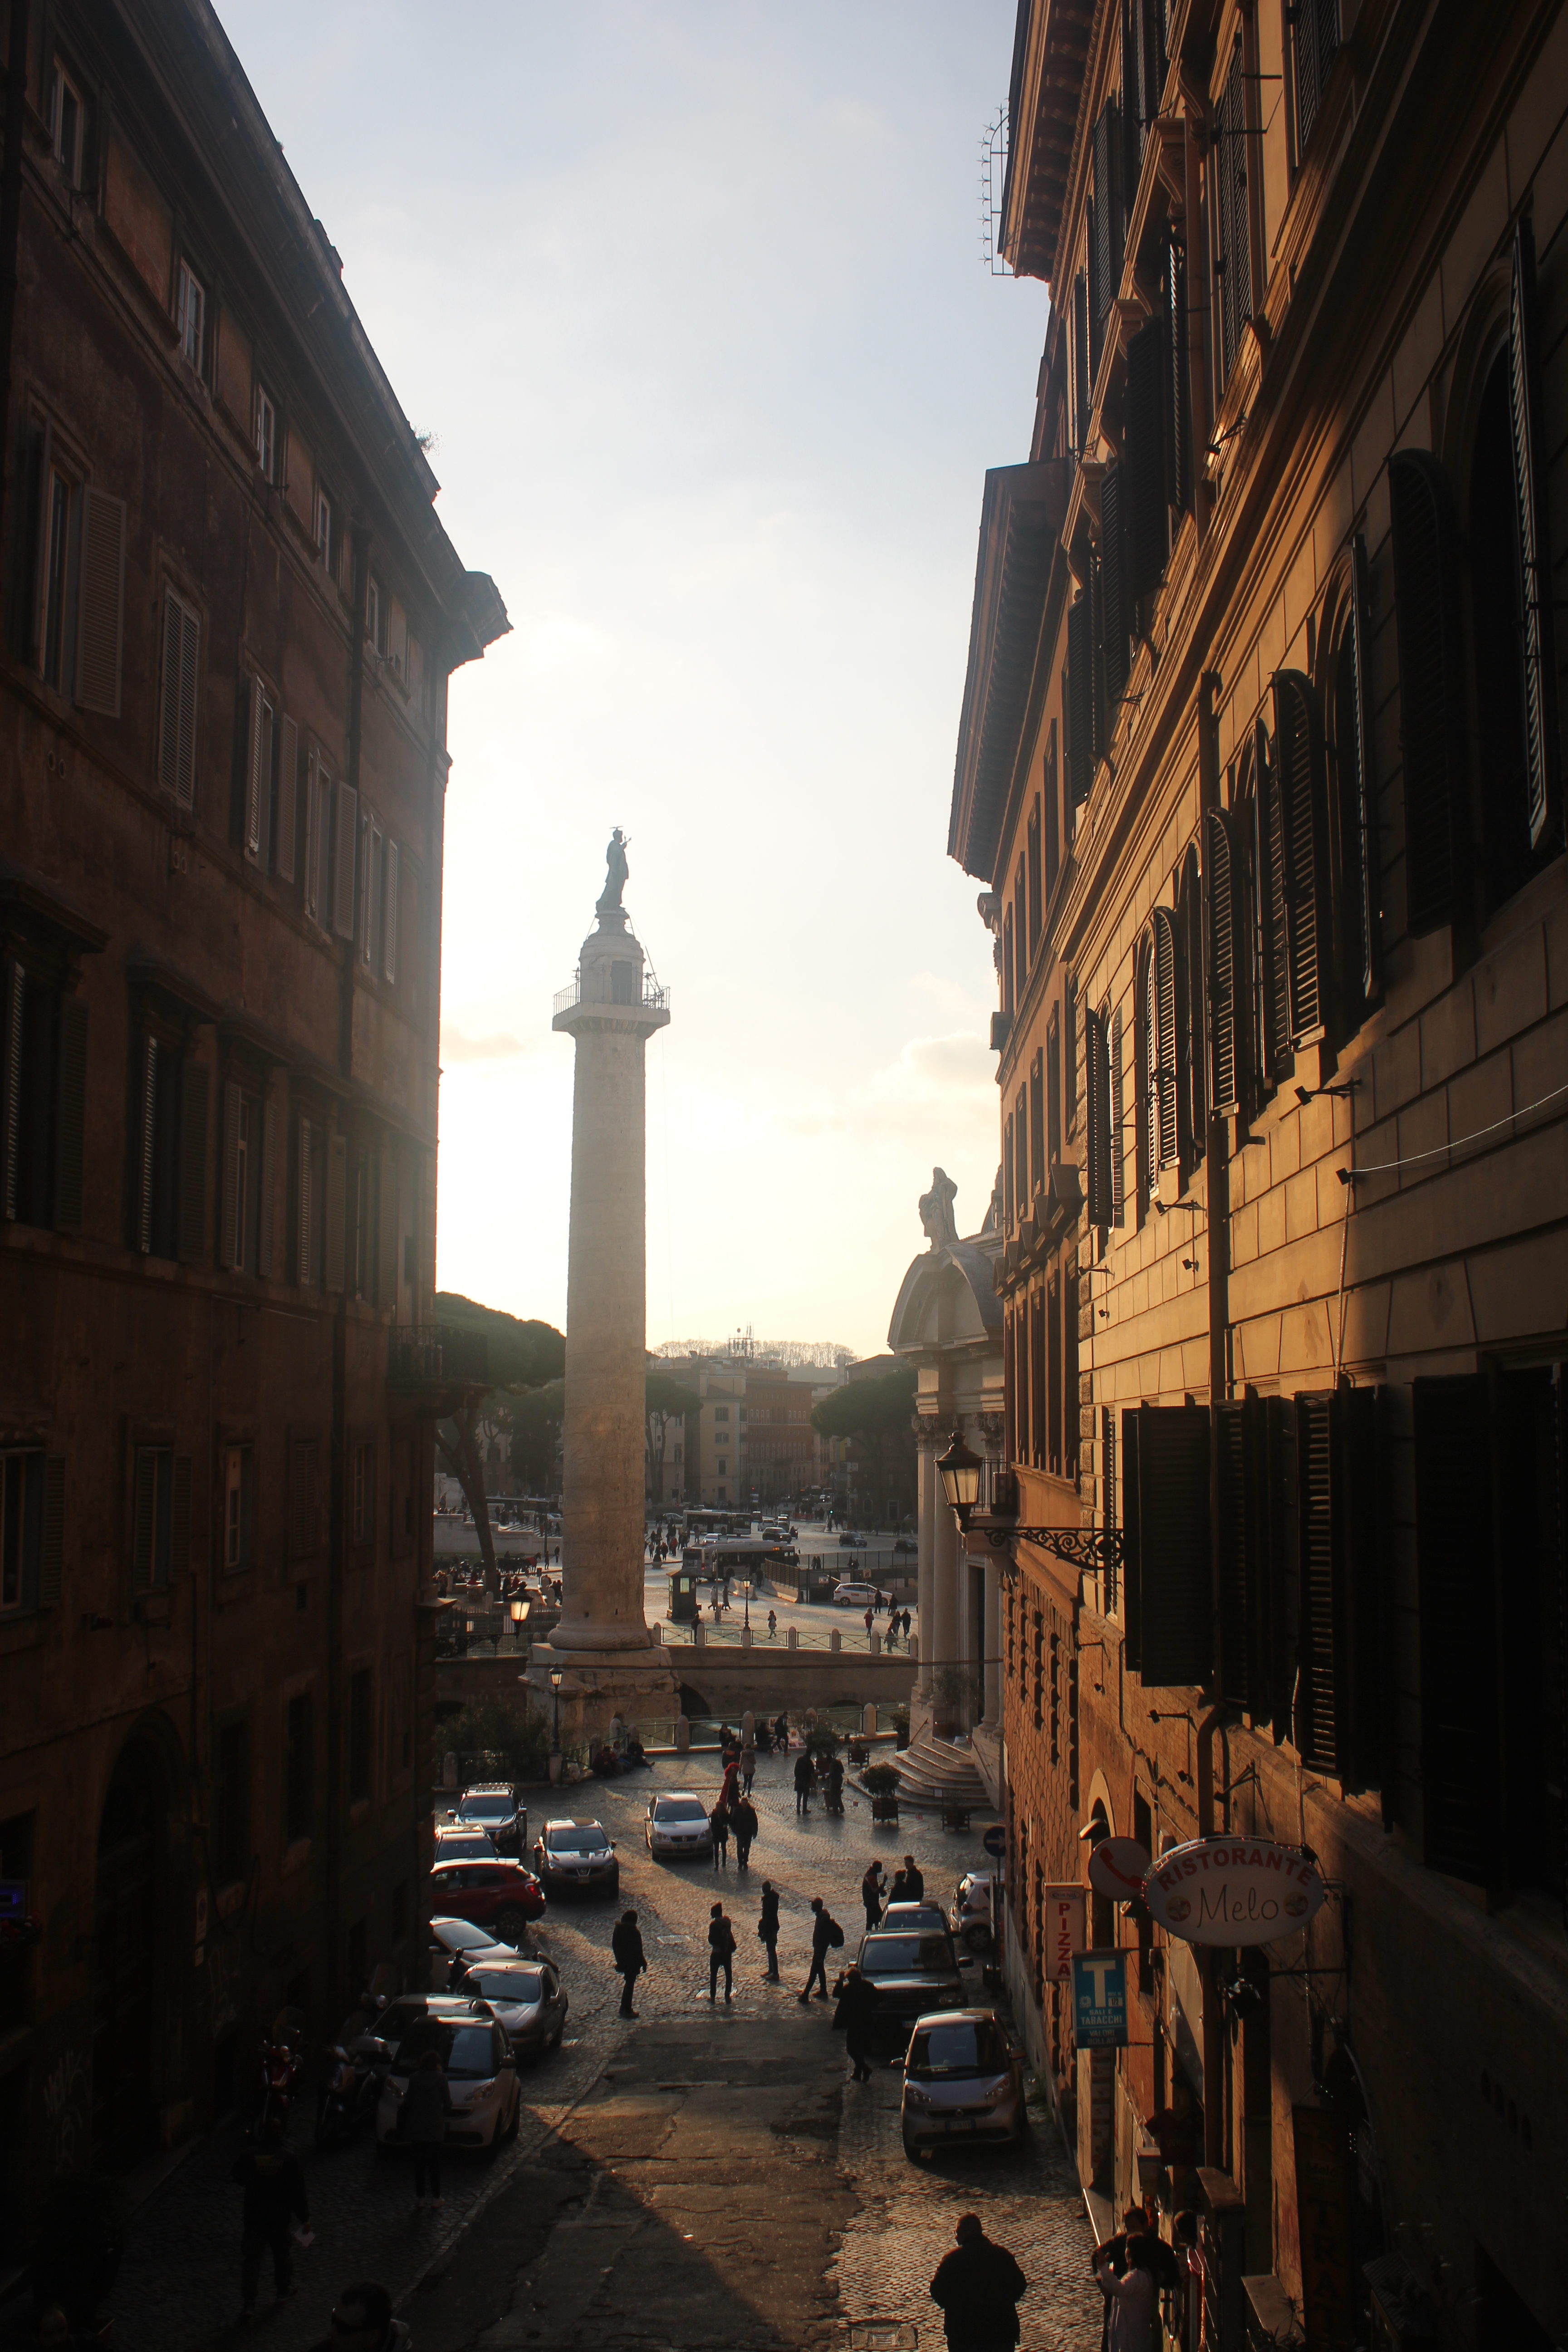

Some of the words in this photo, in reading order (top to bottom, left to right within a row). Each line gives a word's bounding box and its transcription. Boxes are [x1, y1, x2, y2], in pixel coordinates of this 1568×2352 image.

[1156, 1847, 1316, 1892] RISTORANTE
[1197, 1884, 1280, 1928] Melo
[1057, 1902, 1071, 1976] PIZZA
[1083, 1960, 1116, 2008] T
[1081, 2015, 1122, 2026] TABACCHI
[1087, 2037, 1117, 2045] BOLLATI
